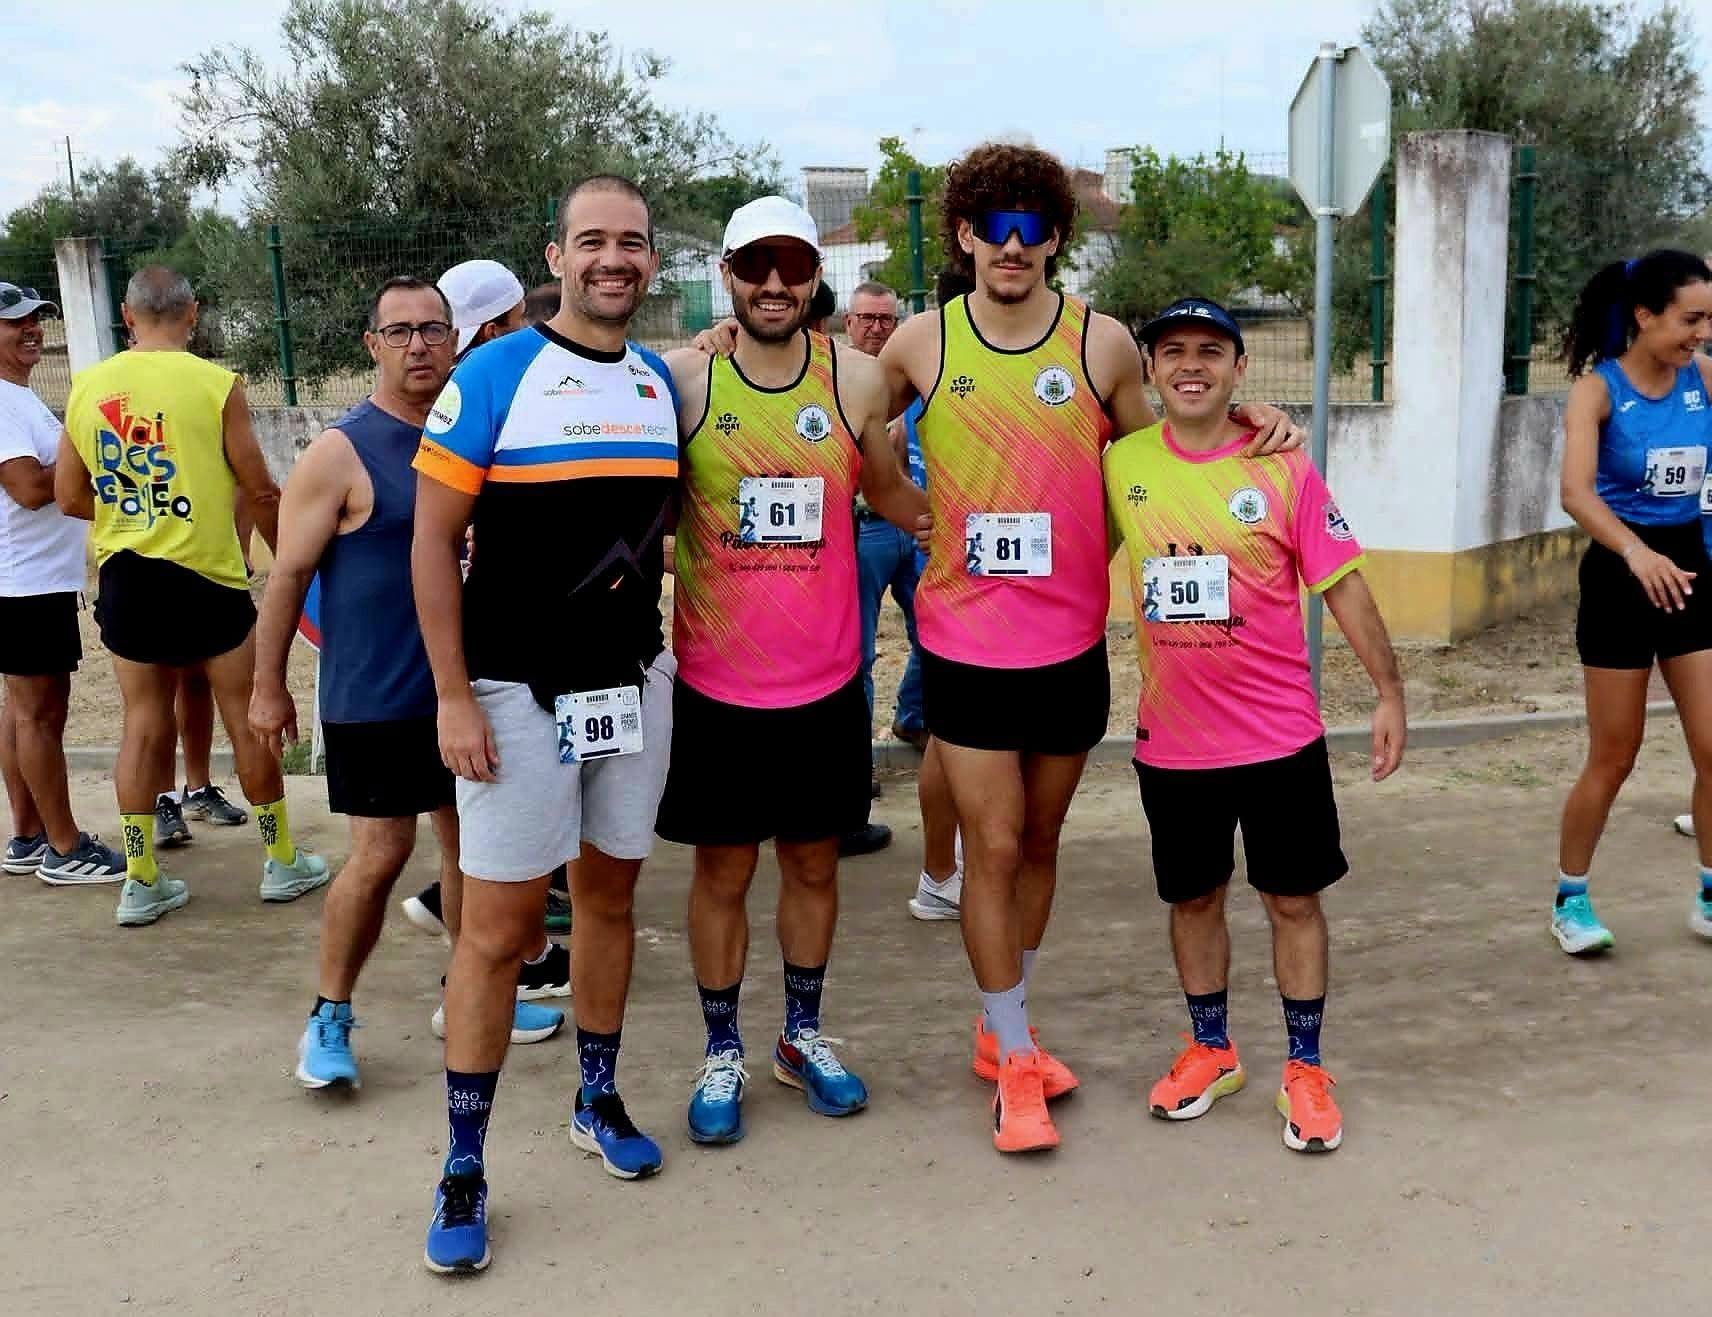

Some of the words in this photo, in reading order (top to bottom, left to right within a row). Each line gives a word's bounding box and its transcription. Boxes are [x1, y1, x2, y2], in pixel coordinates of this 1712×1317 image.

[950, 385, 976, 393] SPORT
[1665, 466, 1686, 485] 59
[769, 502, 796, 527] 61
[996, 537, 1021, 561] 81
[1170, 580, 1200, 605] 50
[585, 715, 614, 743] 98
[453, 1088, 480, 1101] SÃO
